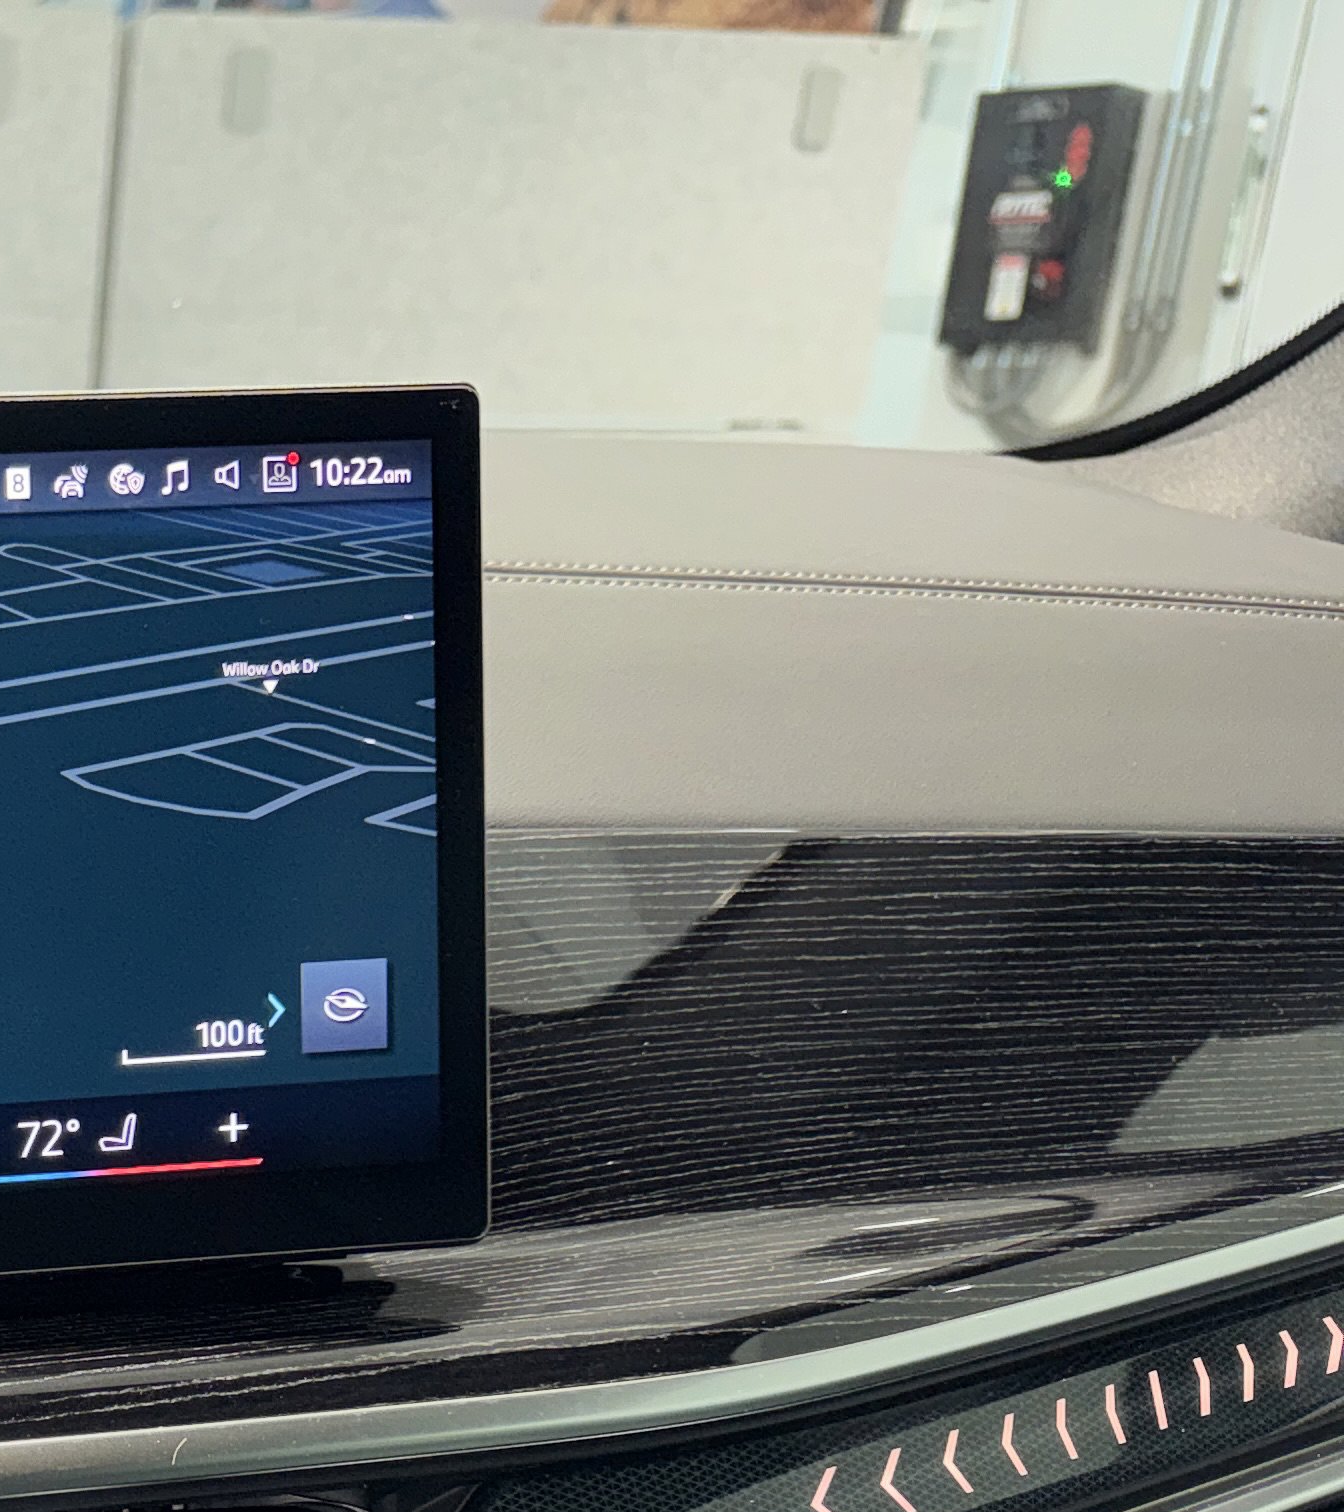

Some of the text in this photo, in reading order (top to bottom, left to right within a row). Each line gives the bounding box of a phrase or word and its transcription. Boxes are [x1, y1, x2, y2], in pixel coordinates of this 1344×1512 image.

[309, 456, 412, 487] 10:22am
[221, 658, 320, 677] Willow Oak Dr
[195, 1018, 265, 1048] 100 ft
